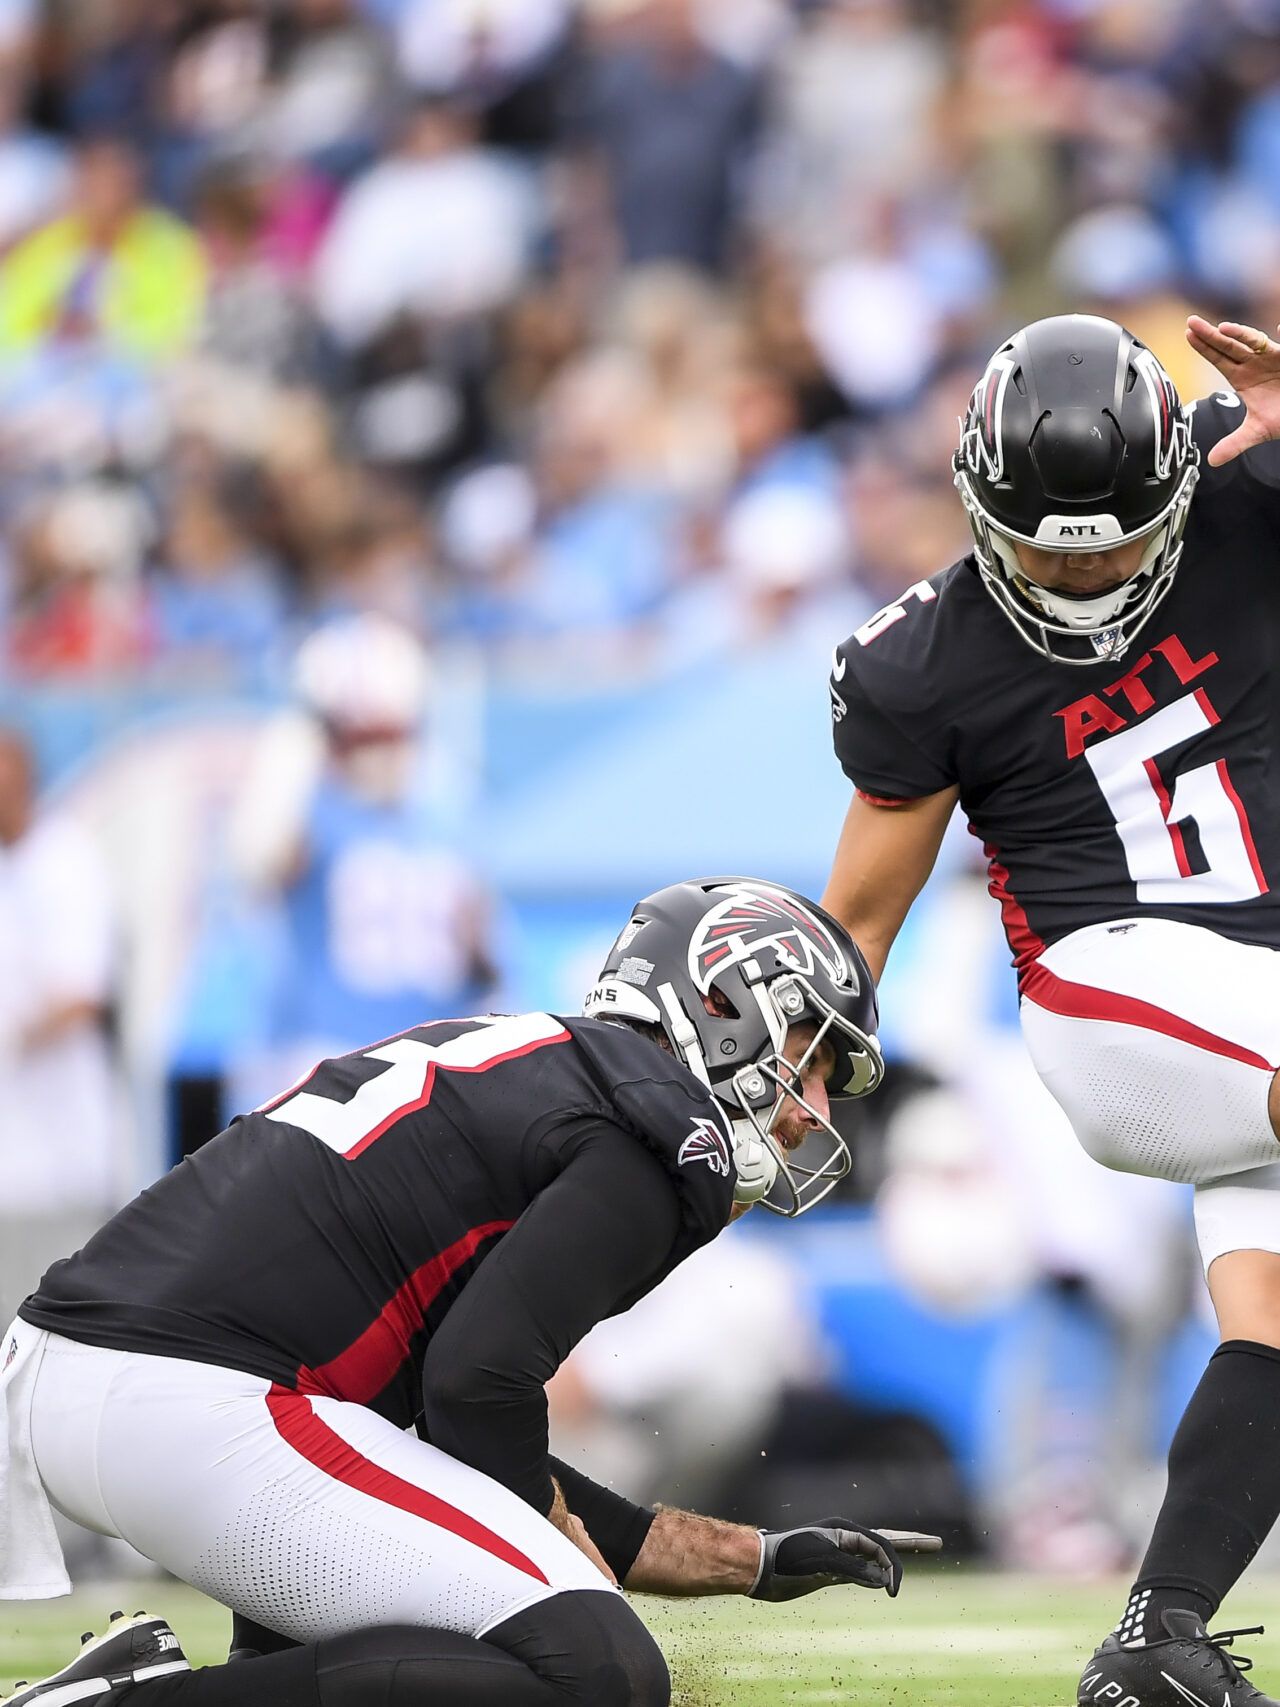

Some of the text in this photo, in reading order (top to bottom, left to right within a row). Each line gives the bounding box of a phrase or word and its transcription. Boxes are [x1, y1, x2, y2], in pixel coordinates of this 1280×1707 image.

[1059, 525, 1101, 536] ATL
[1052, 634, 1220, 760] ATL
[1084, 687, 1270, 904] 6
